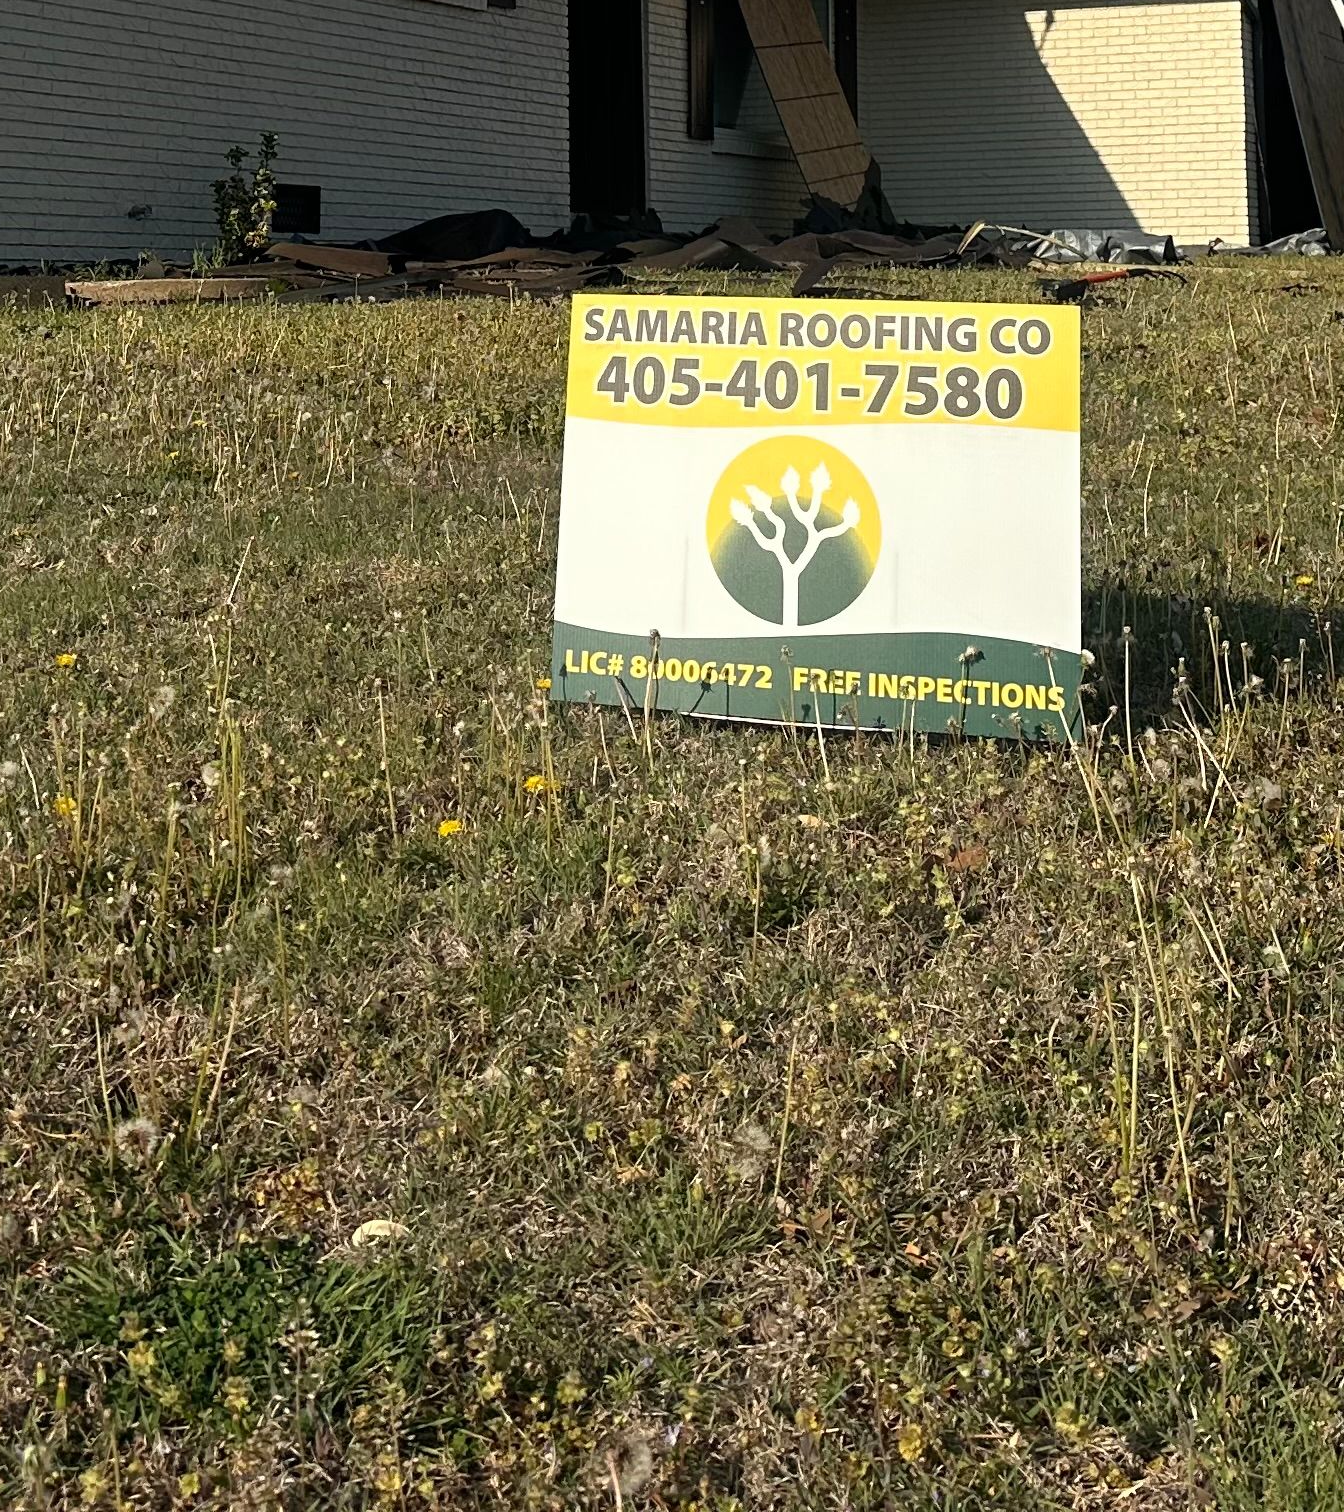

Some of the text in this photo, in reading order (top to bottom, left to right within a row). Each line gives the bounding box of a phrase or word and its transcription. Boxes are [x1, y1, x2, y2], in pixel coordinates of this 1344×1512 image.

[585, 309, 1051, 355] SAMARIA ROOFING CO
[597, 356, 1023, 419] 405-401-7580
[566, 649, 1066, 711] LIC# 80006472 FREE INSPECTIONS
